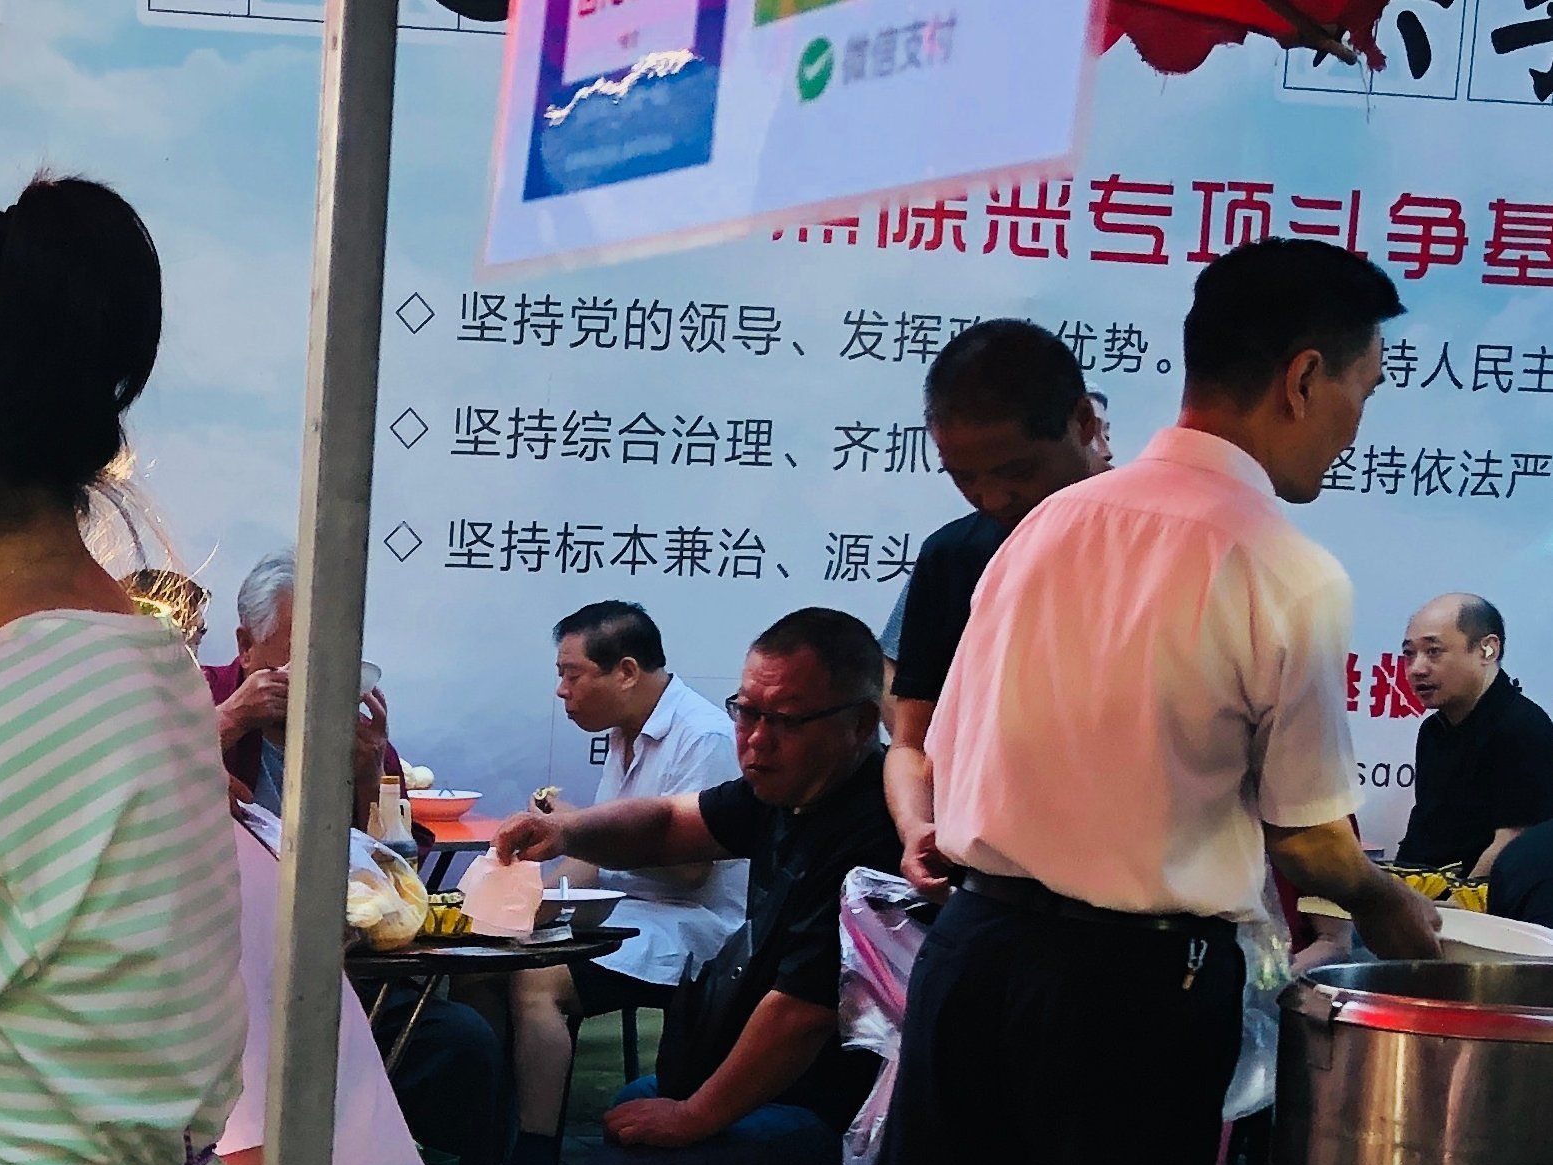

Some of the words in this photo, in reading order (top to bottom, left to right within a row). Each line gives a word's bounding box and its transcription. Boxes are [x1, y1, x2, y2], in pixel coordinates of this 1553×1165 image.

[772, 173, 1553, 288] 除恶专项斗争基
[457, 291, 1173, 374] 坚持党的领导、发挥优势。
[451, 405, 947, 474] 坚持综合治理、齐抓
